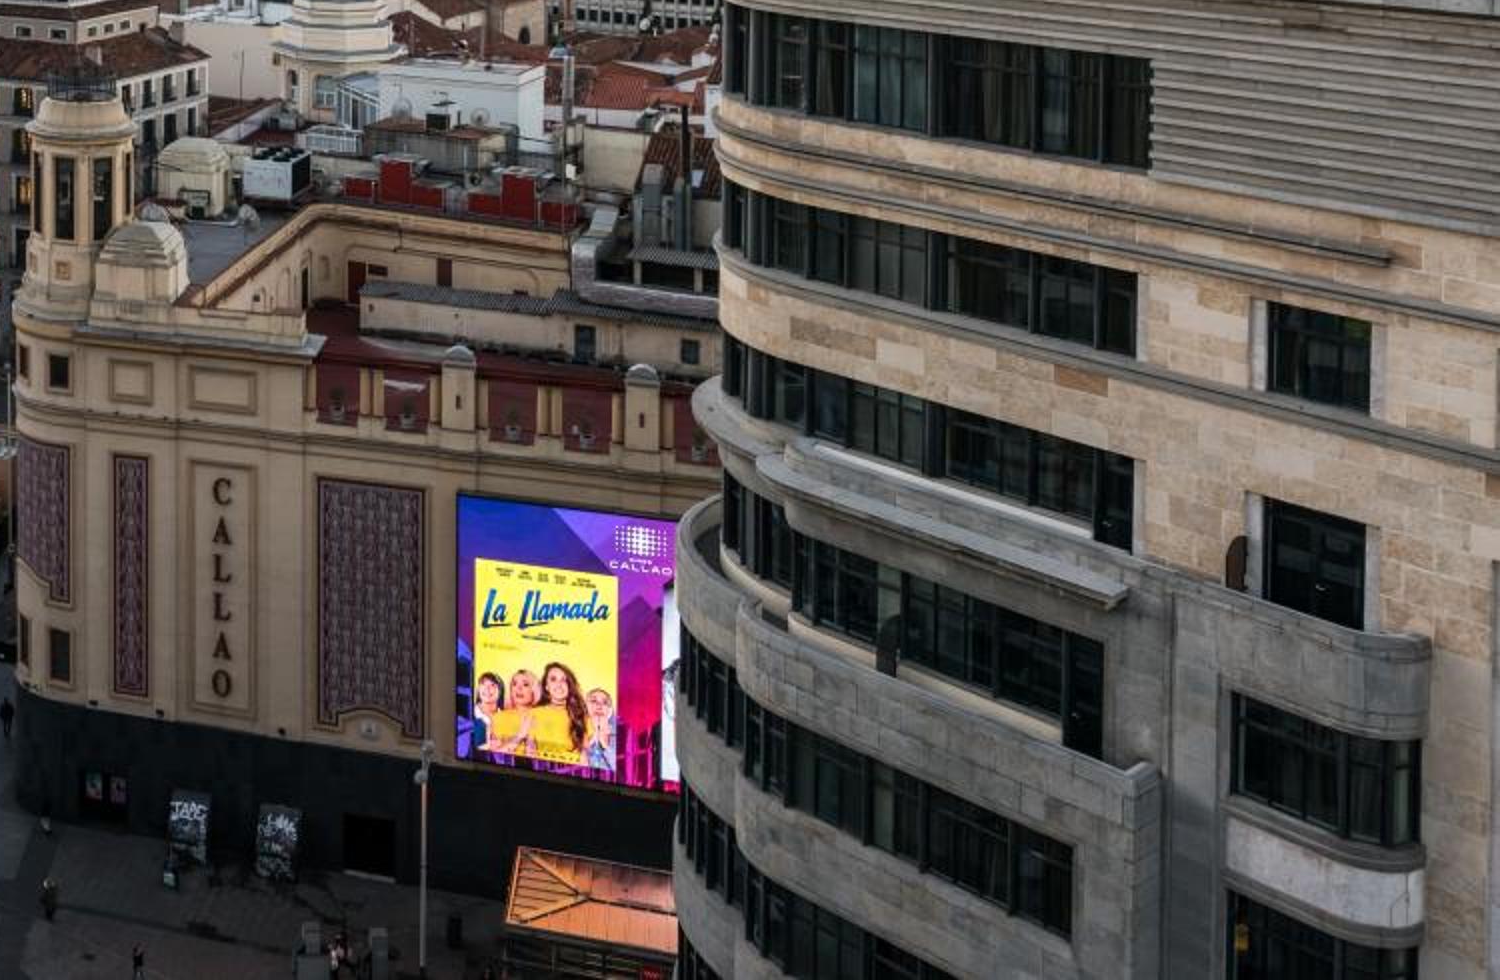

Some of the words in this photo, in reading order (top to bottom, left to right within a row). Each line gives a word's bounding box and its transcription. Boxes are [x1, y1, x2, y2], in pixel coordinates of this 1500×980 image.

[211, 476, 233, 699] CALLAO
[609, 560, 673, 576] CALLAO
[480, 588, 511, 629] La
[517, 589, 610, 630] Llamada
